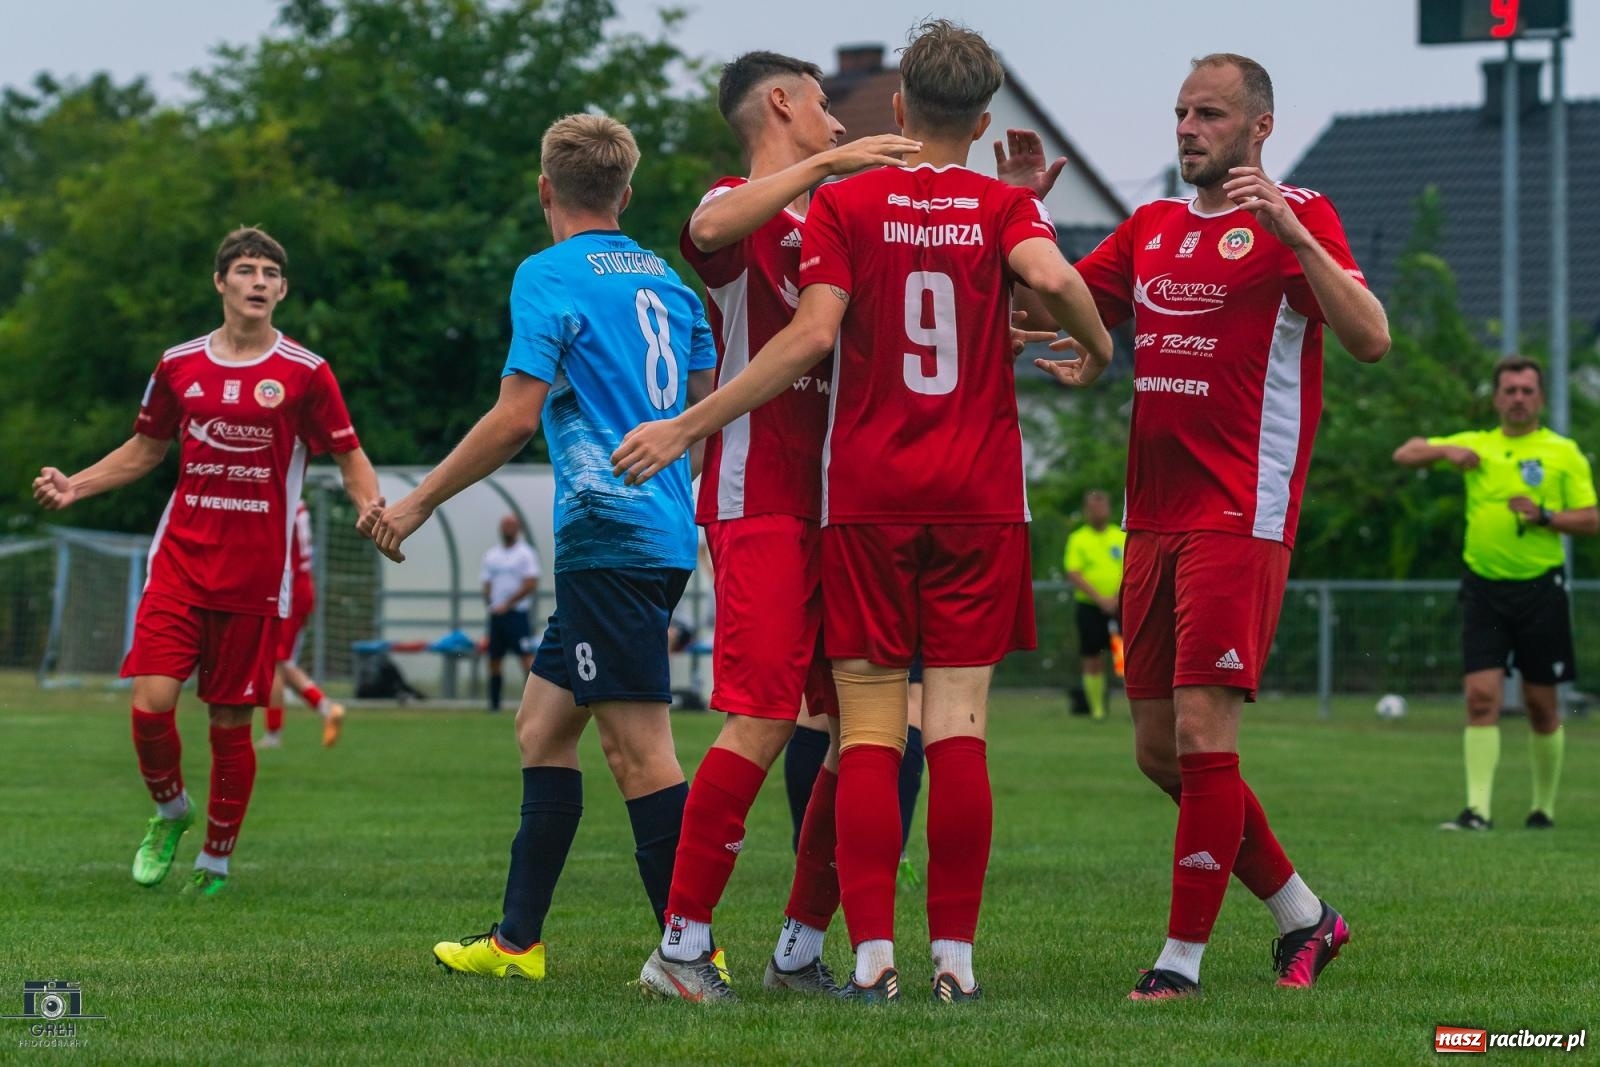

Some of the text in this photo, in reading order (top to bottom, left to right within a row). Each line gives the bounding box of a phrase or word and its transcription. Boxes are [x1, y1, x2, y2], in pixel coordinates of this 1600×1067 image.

[1153, 279, 1228, 300] REKPOL
[903, 270, 958, 395] 9
[635, 288, 678, 411] 8
[1162, 334, 1218, 350] TRANS
[212, 421, 273, 439] REKPOL
[227, 465, 271, 478] TRANS
[200, 496, 269, 513] WENINGER
[575, 641, 597, 682] 8
[1215, 661, 1244, 670] adidas
